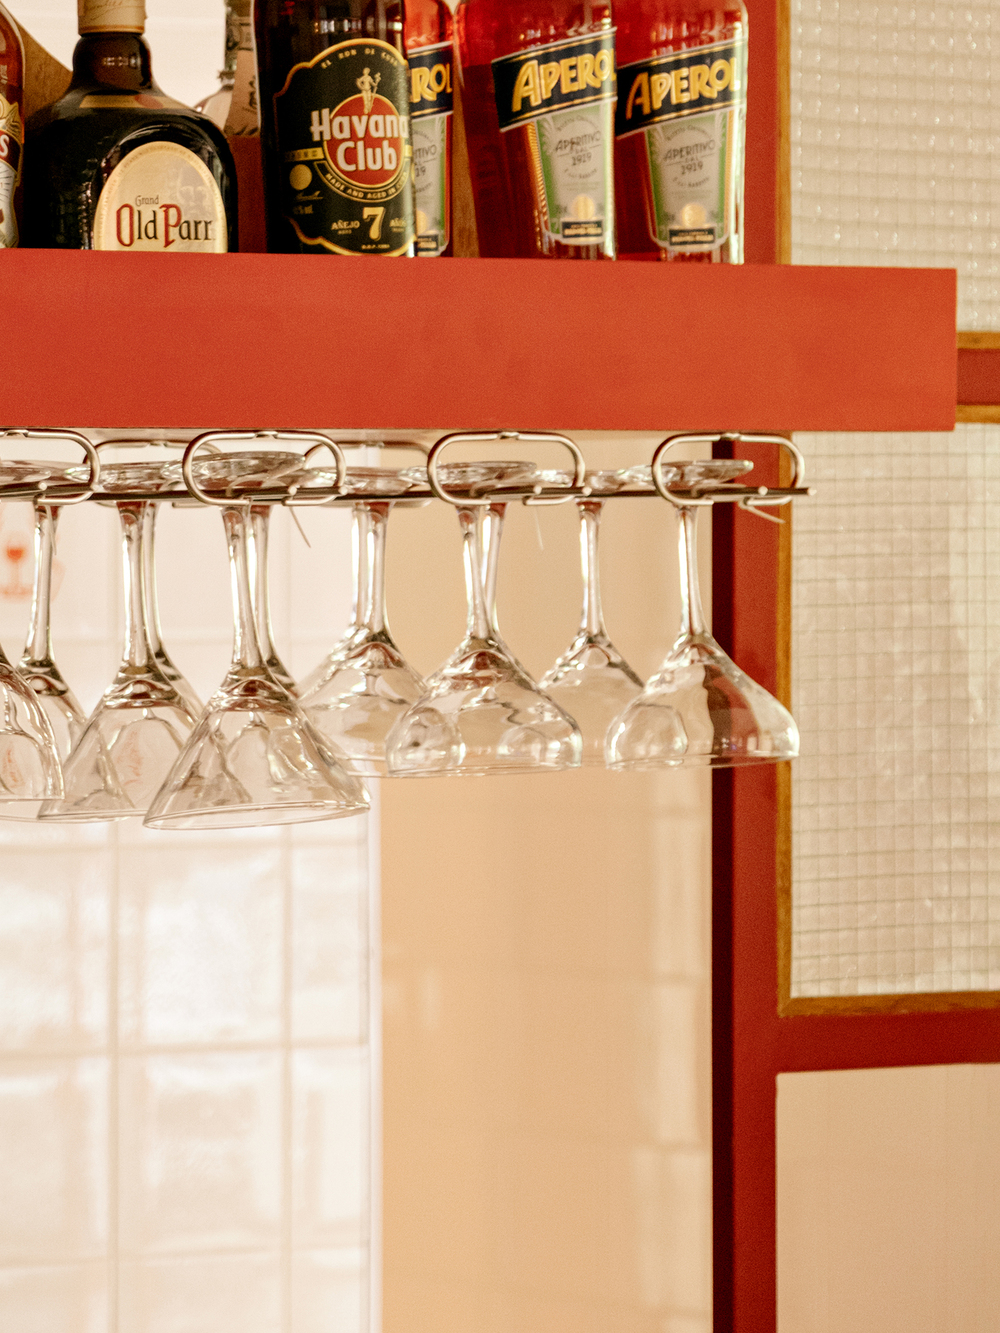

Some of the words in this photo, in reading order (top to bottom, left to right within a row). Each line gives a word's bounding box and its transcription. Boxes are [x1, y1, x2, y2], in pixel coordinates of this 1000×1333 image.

[409, 64, 453, 103] ROL
[512, 48, 617, 113] APEROL
[625, 56, 741, 120] APEROL
[310, 108, 409, 141] Havana
[336, 140, 398, 172] Club
[663, 139, 716, 162] APERITIVO
[681, 160, 704, 175] 1919
[135, 194, 160, 207] Grand
[324, 172, 345, 192] MADE
[348, 187, 364, 199] AND
[366, 191, 387, 200] AGED
[116, 203, 159, 247] Old
[159, 204, 214, 248] Parr
[331, 219, 360, 231] AÑEJO
[362, 206, 386, 242] 7
